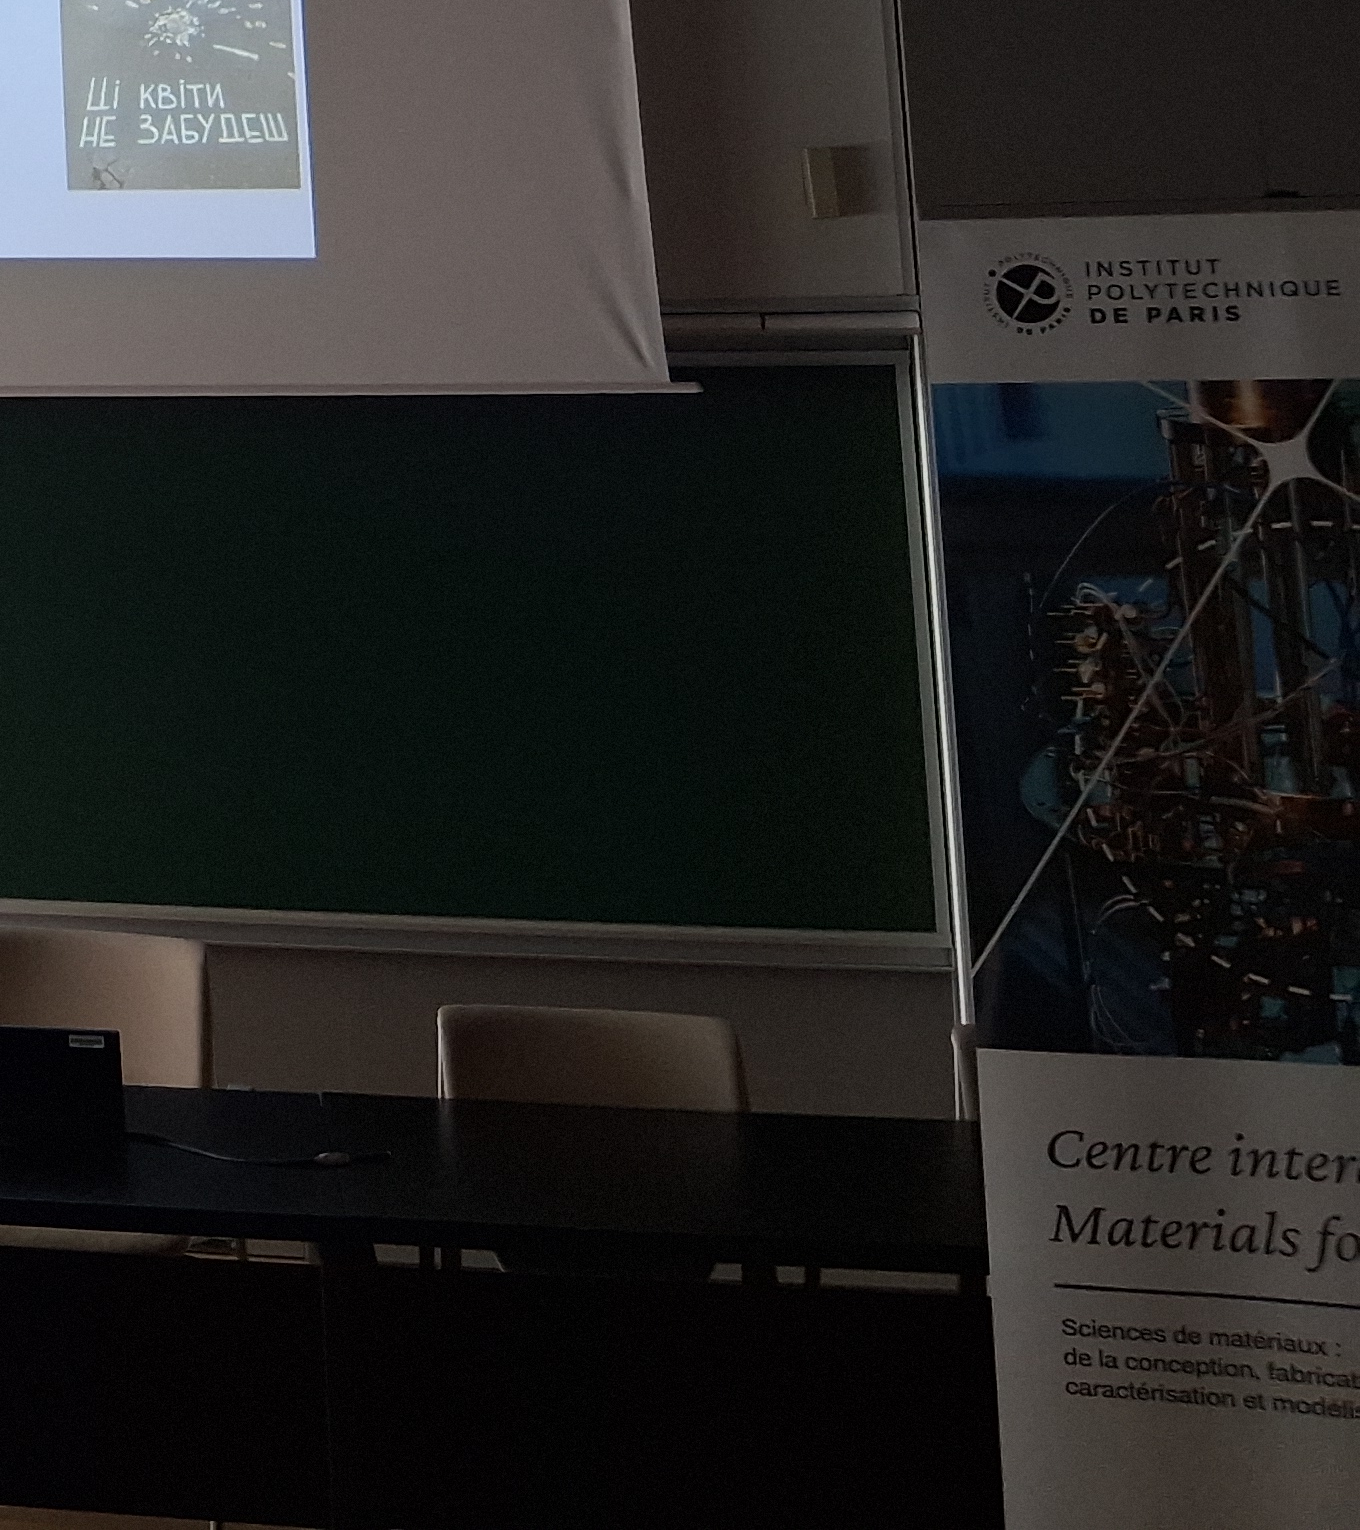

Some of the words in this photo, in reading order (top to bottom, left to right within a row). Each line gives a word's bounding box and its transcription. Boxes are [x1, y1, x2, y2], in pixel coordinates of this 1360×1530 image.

[79, 115, 117, 148] НЕ
[137, 113, 289, 145] ЗАБУДЕШ
[1084, 258, 1221, 278] INSTITUT
[1087, 279, 1341, 300] POLYTECHNIQUE
[1090, 307, 1129, 324] DE
[1147, 305, 1240, 323] PARIS
[1048, 1130, 1212, 1174] Centre
[1229, 1133, 1360, 1184] inter
[1049, 1204, 1301, 1257] Materials
[1062, 1318, 1166, 1343] Sciences
[1173, 1325, 1201, 1344] de
[1064, 1347, 1092, 1367] de
[1098, 1349, 1119, 1369] la
[1125, 1356, 1260, 1380] conception,
[1065, 1381, 1236, 1407] caractérisation
[1243, 1394, 1266, 1411] et
